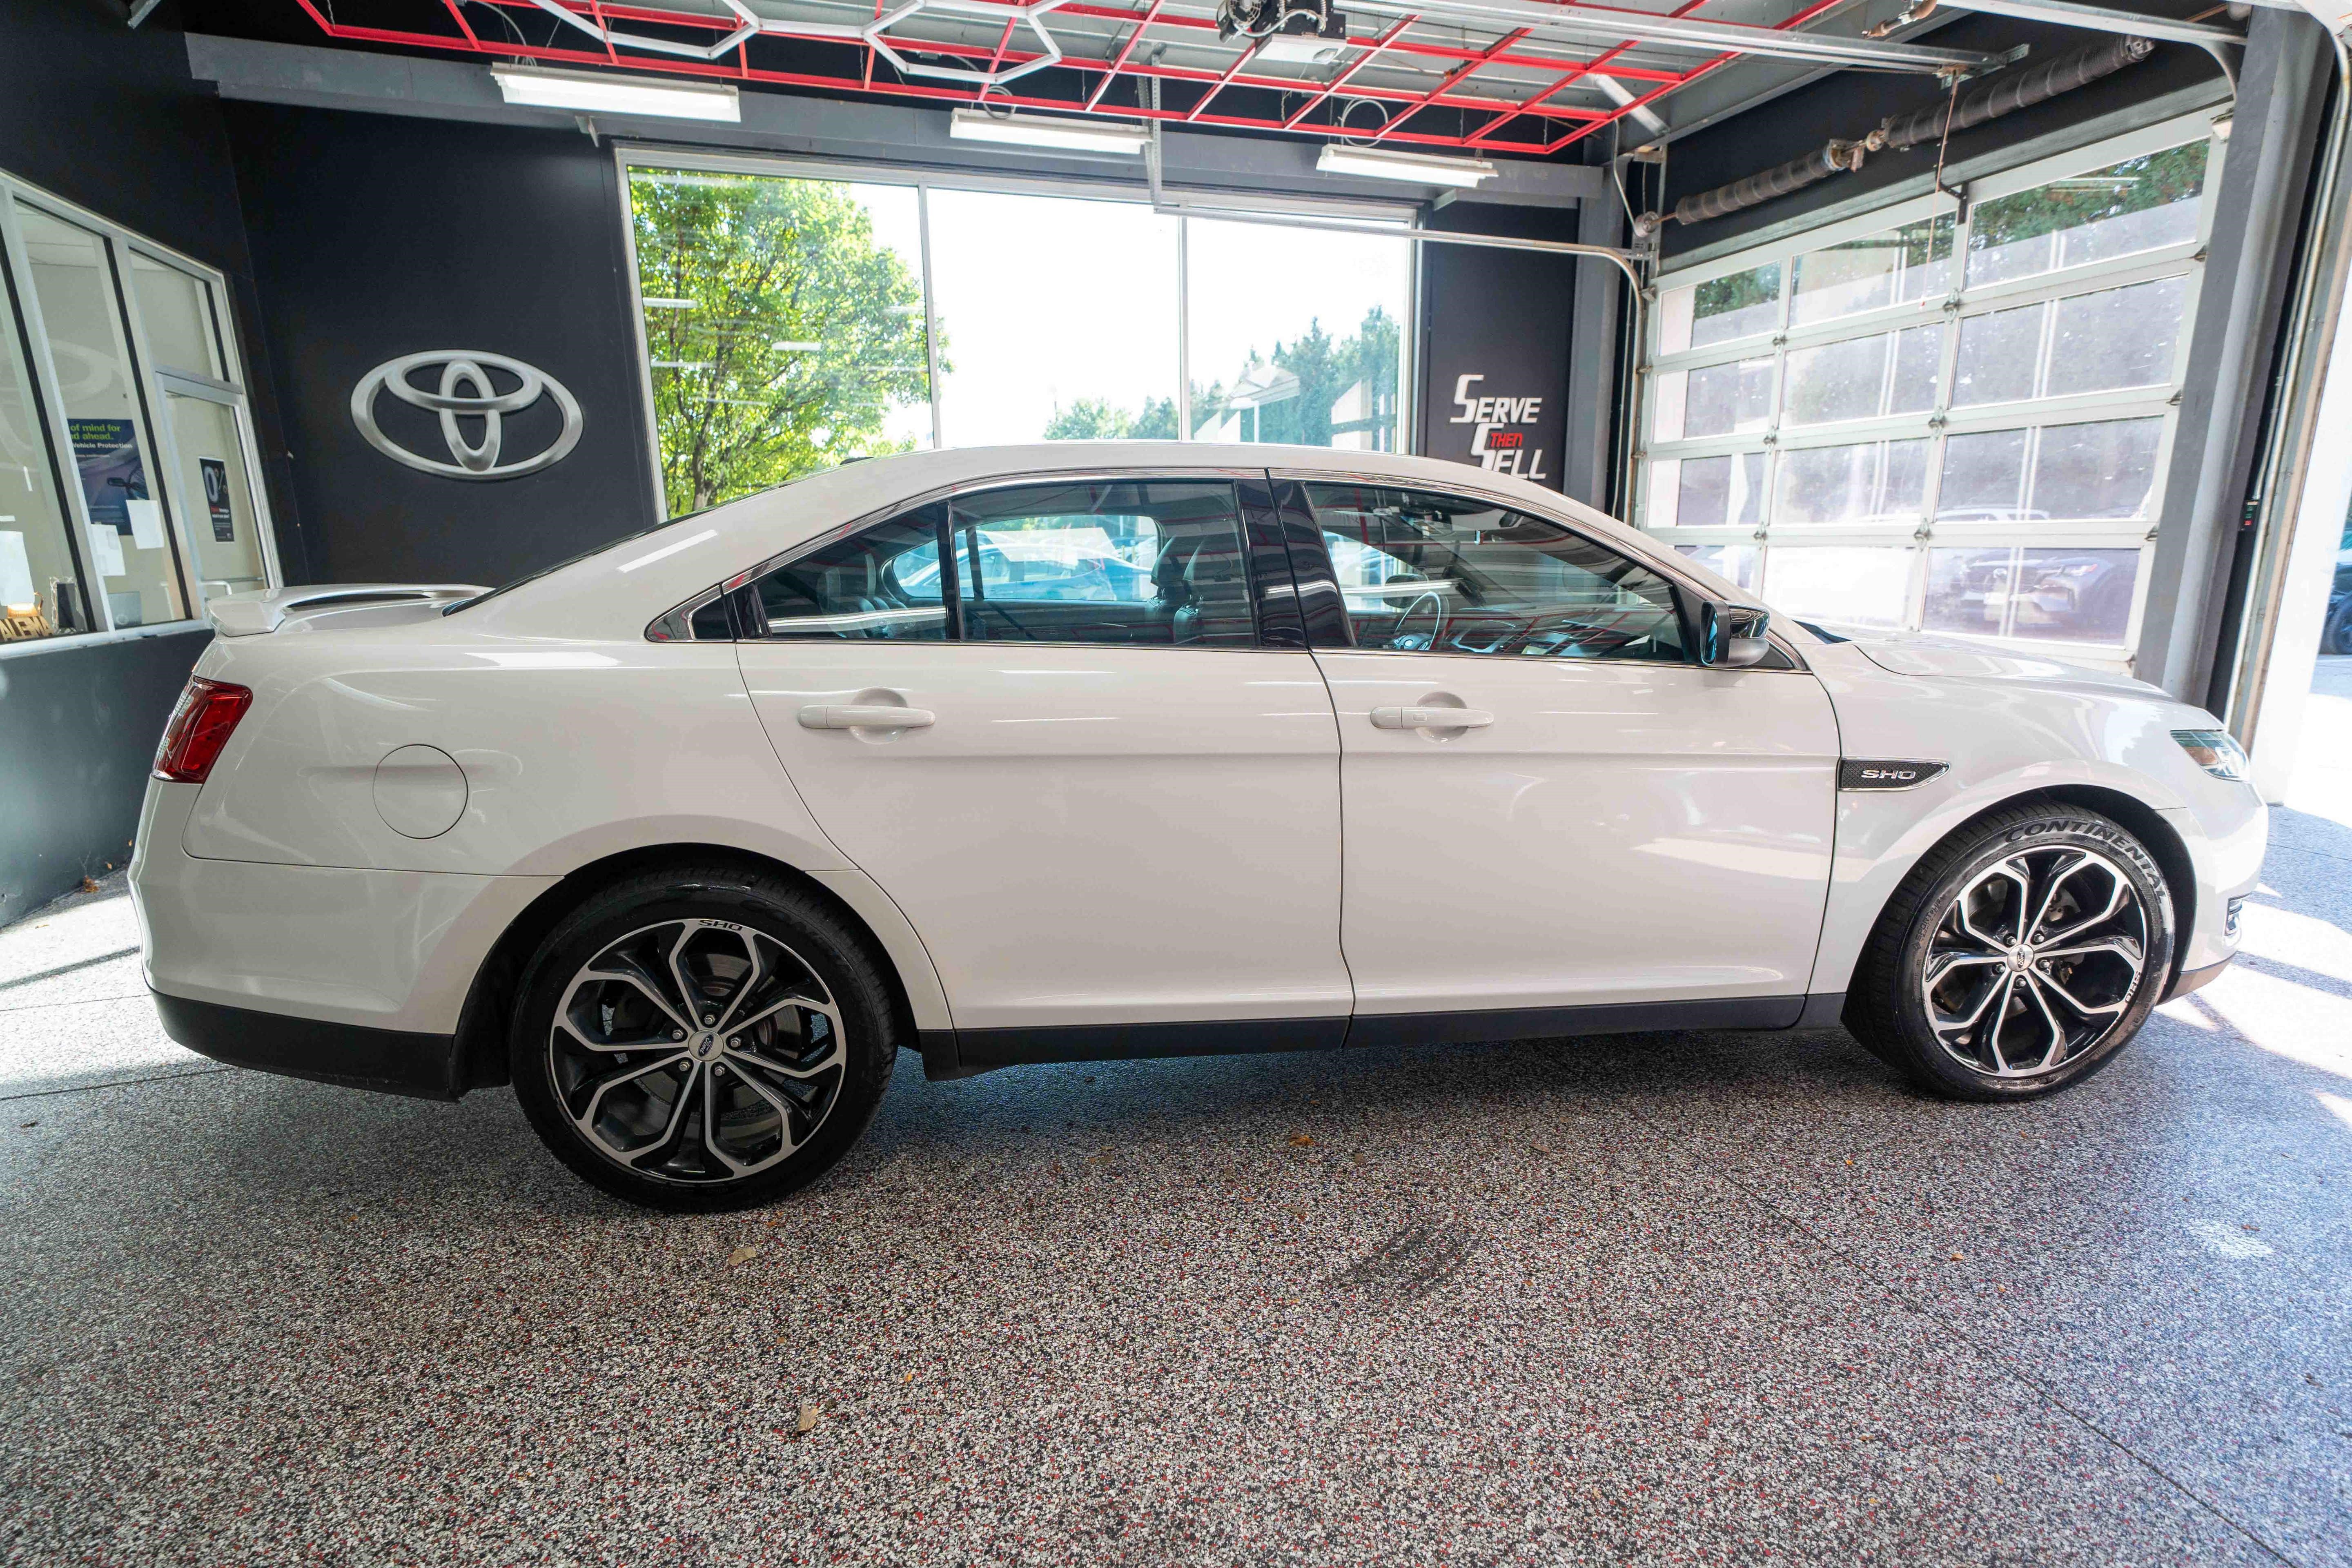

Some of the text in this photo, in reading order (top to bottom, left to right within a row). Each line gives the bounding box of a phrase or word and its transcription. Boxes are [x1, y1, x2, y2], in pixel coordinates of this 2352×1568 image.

[1450, 374, 1542, 423] SERVE
[1471, 423, 1546, 479] SELL
[1491, 432, 1523, 448] THEN
[204, 466, 229, 503] 0%
[1861, 770, 1916, 779] SHO
[2005, 820, 2165, 904] CONTINENTAL
[698, 920, 743, 931] SHO
[2125, 971, 2140, 1004] SHO
[699, 1037, 712, 1054] Ford
